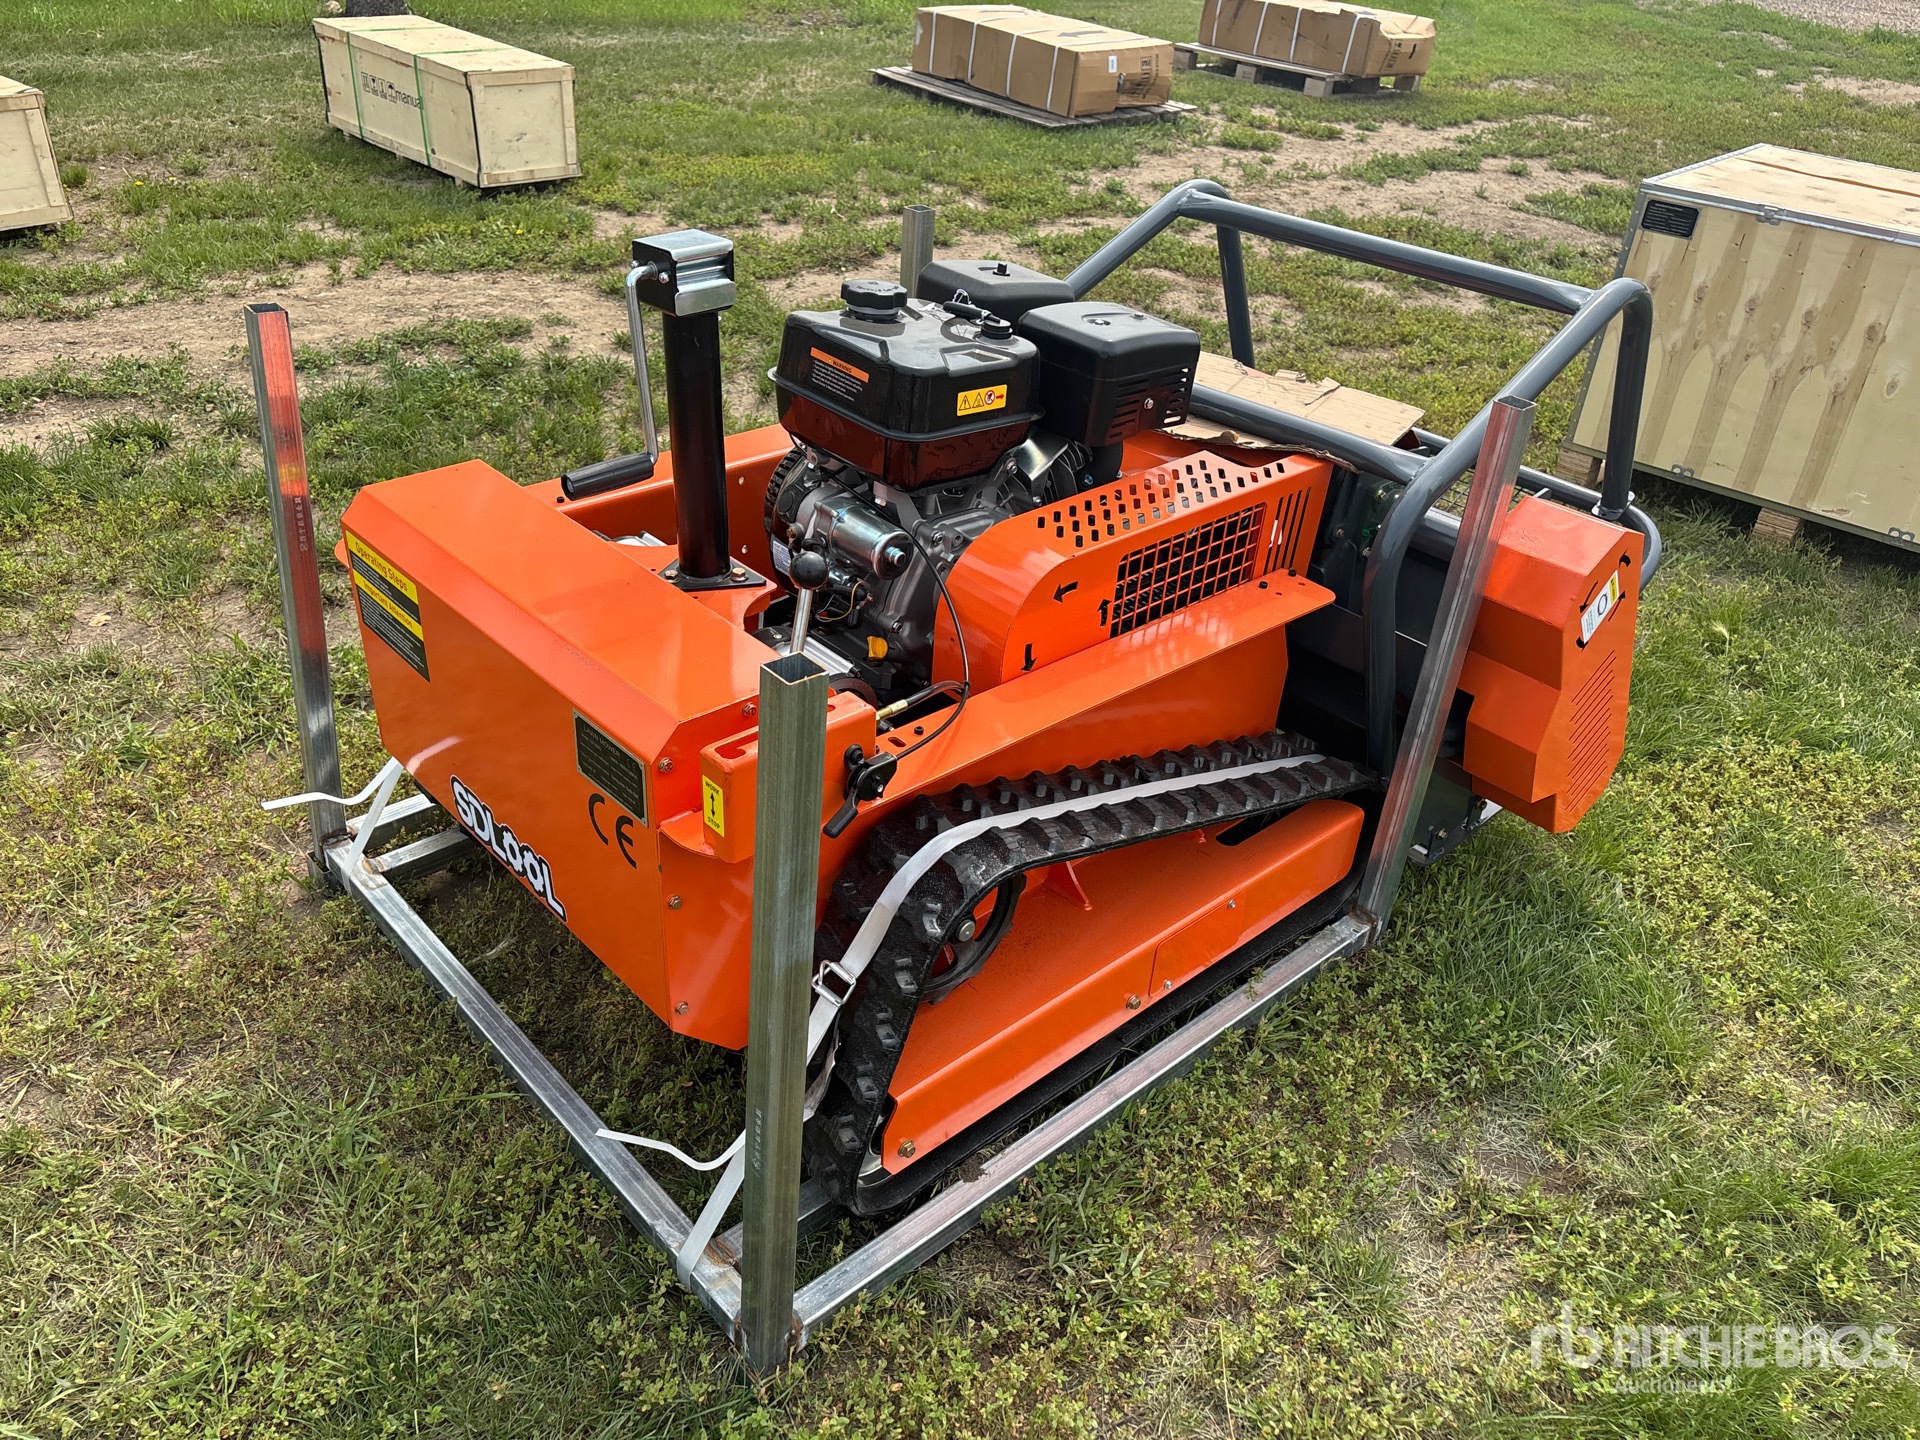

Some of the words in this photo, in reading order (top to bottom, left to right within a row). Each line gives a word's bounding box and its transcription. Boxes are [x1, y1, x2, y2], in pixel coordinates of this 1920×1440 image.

[395, 90, 424, 110] manual
[355, 541, 388, 578] Operating
[387, 568, 408, 592] Steps
[705, 780, 720, 797] WORK
[588, 793, 637, 870] CE
[707, 816, 721, 829] STOP
[452, 777, 567, 921] SDLOOL
